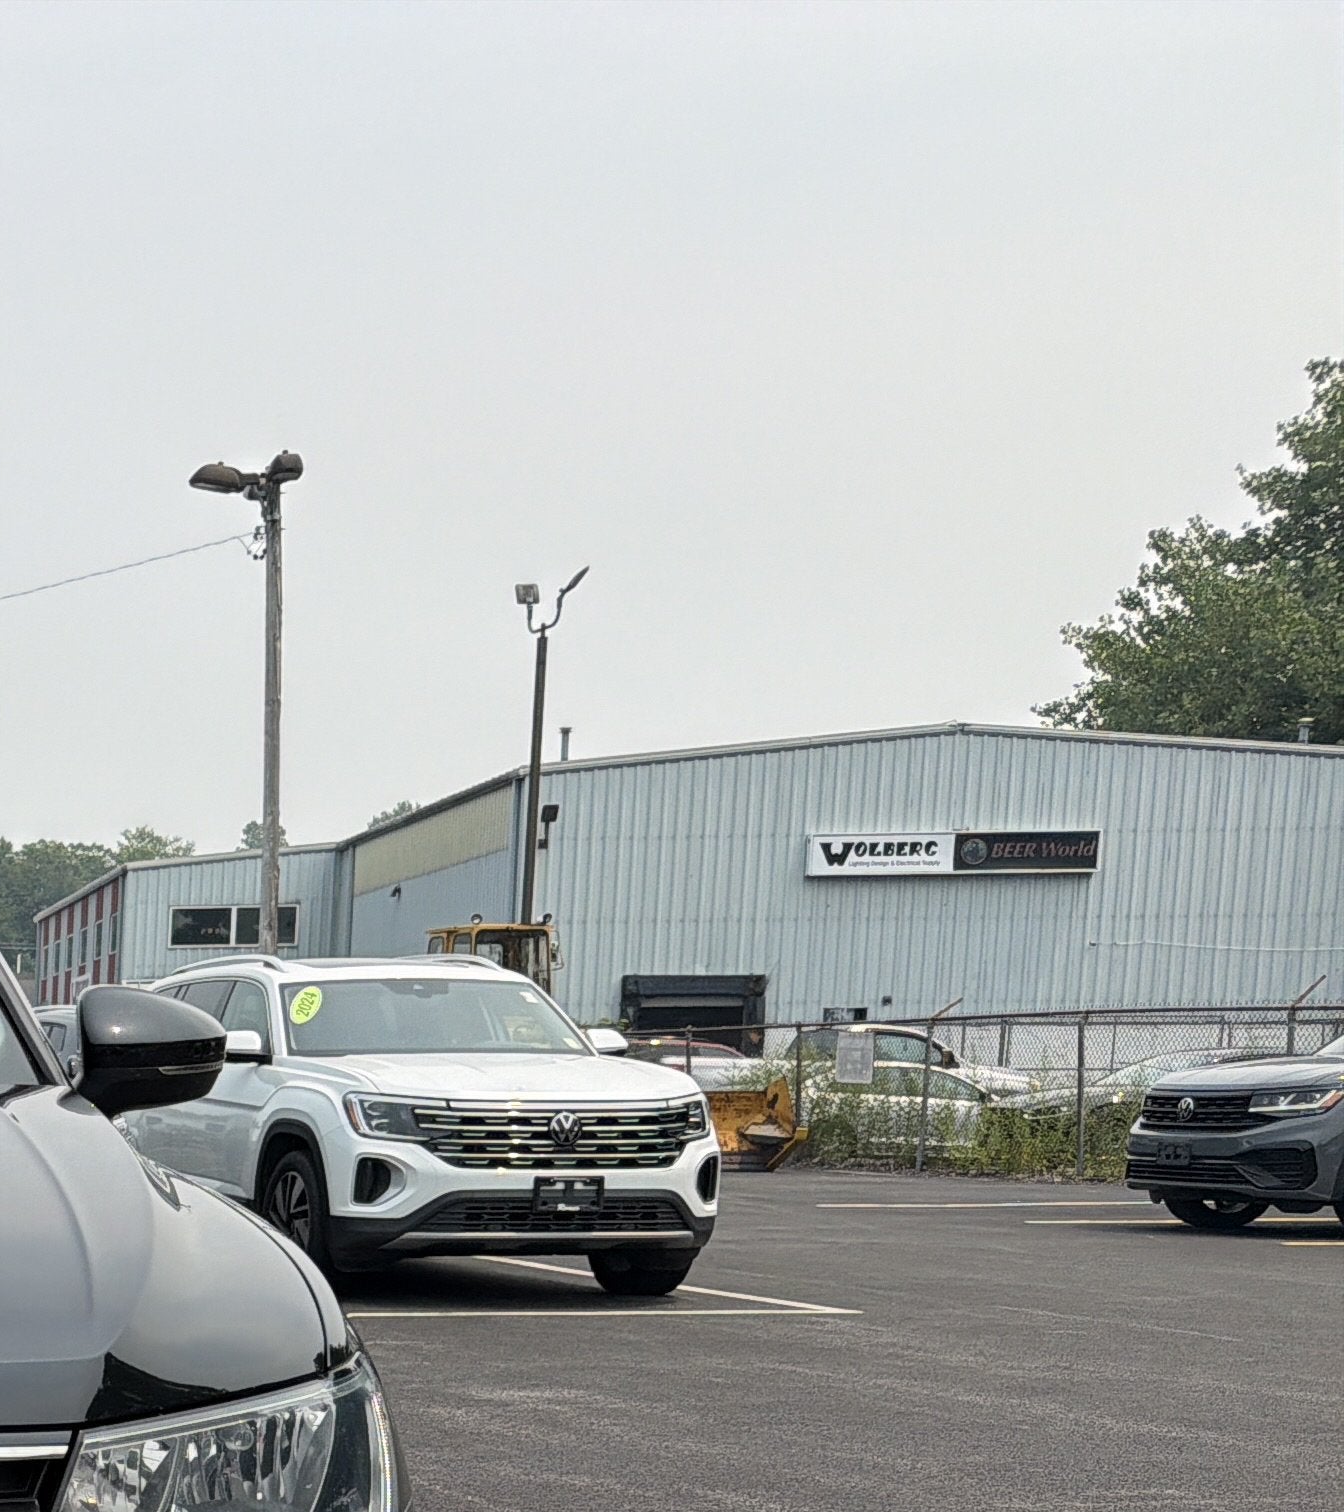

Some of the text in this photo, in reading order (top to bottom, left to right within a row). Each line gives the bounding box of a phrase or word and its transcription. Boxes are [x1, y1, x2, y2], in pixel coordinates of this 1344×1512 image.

[818, 840, 939, 866] WOLBERG
[991, 839, 1096, 858] BEER World
[295, 991, 317, 1018] 2024
